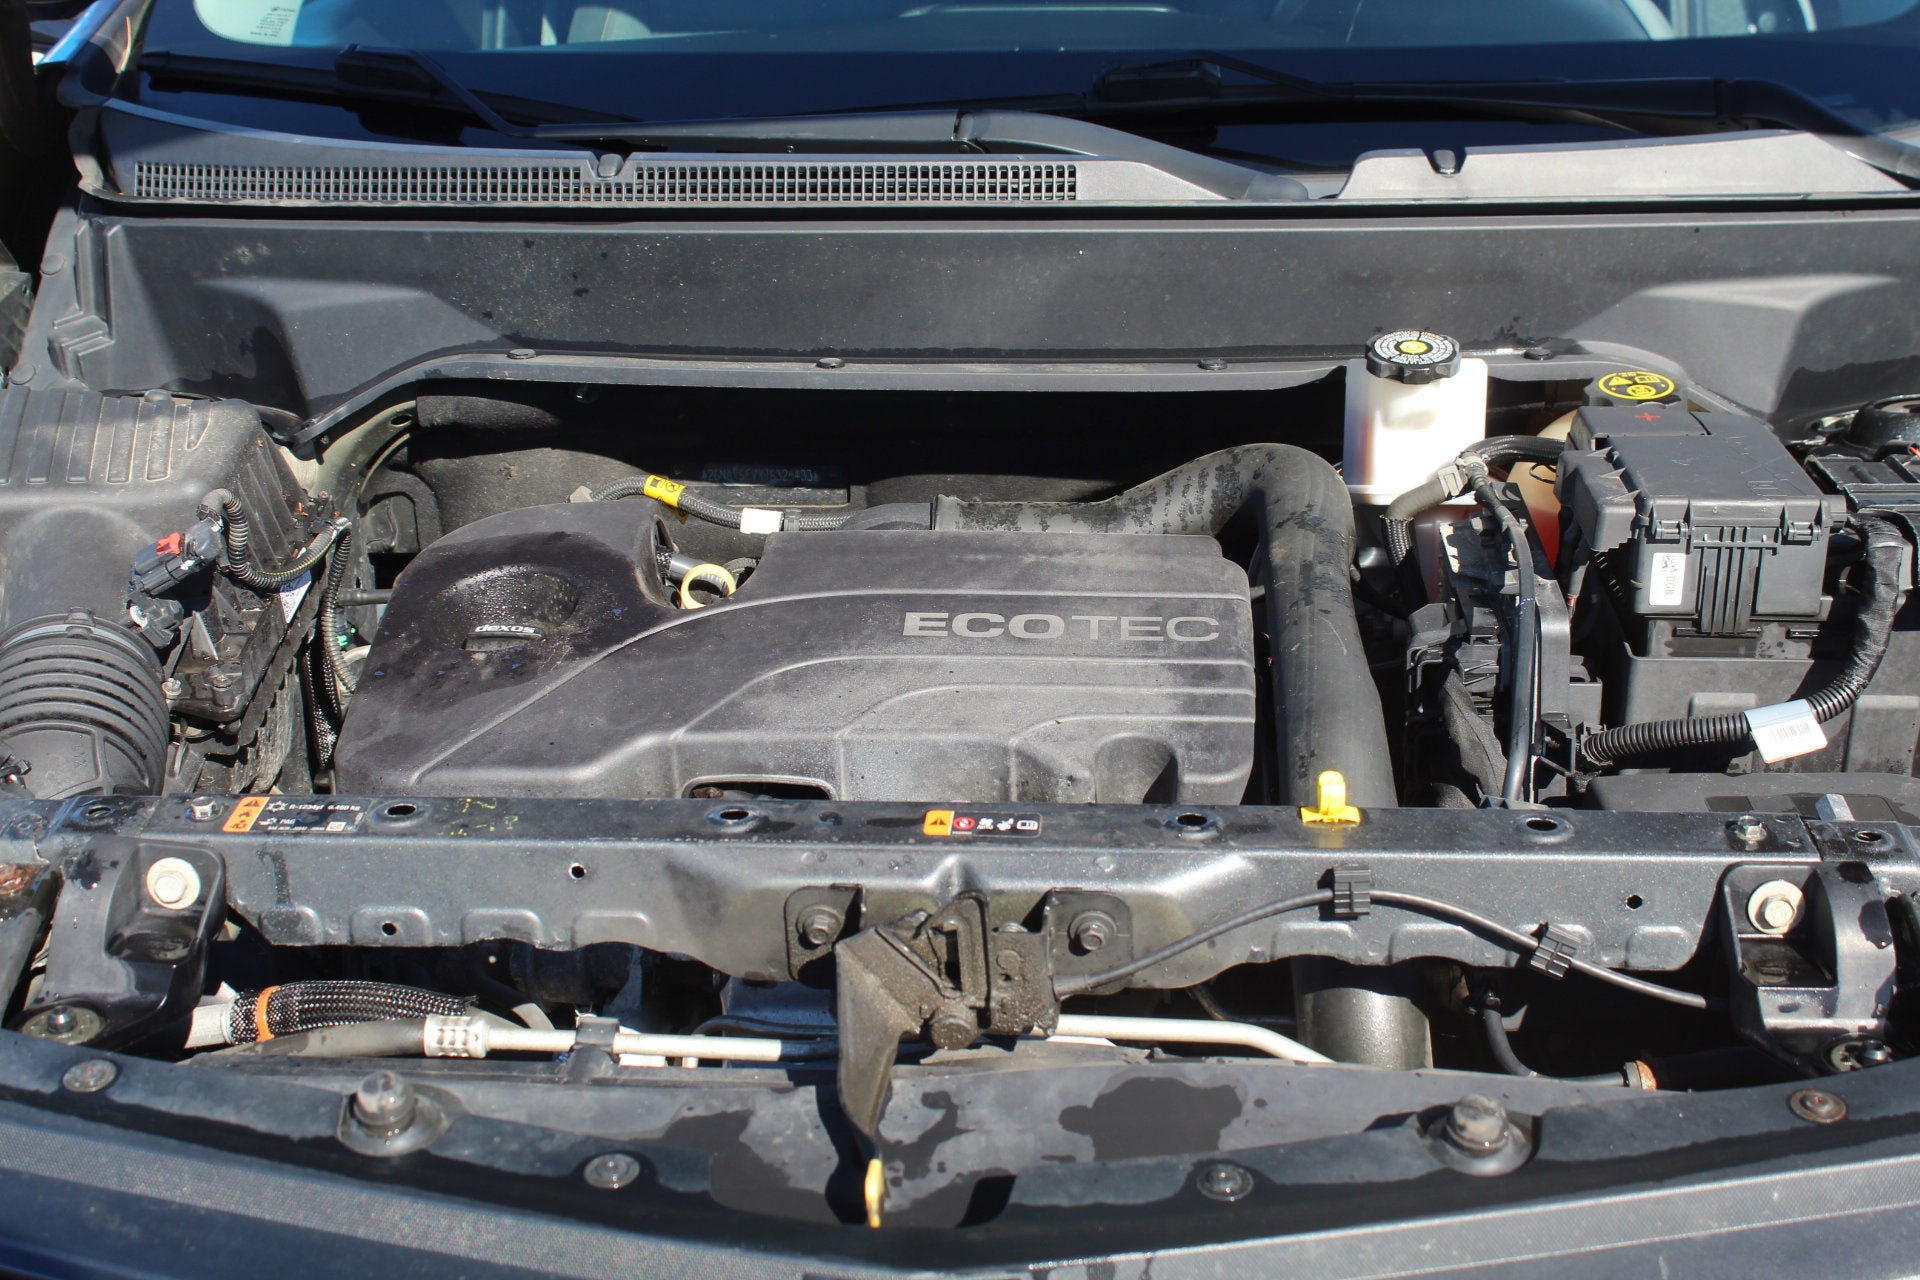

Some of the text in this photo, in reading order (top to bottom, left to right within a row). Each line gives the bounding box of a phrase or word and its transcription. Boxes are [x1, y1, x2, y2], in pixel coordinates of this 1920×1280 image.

[475, 624, 536, 634] dexos
[902, 611, 1220, 642] ECOTEC
[288, 804, 325, 812] R-1234yf
